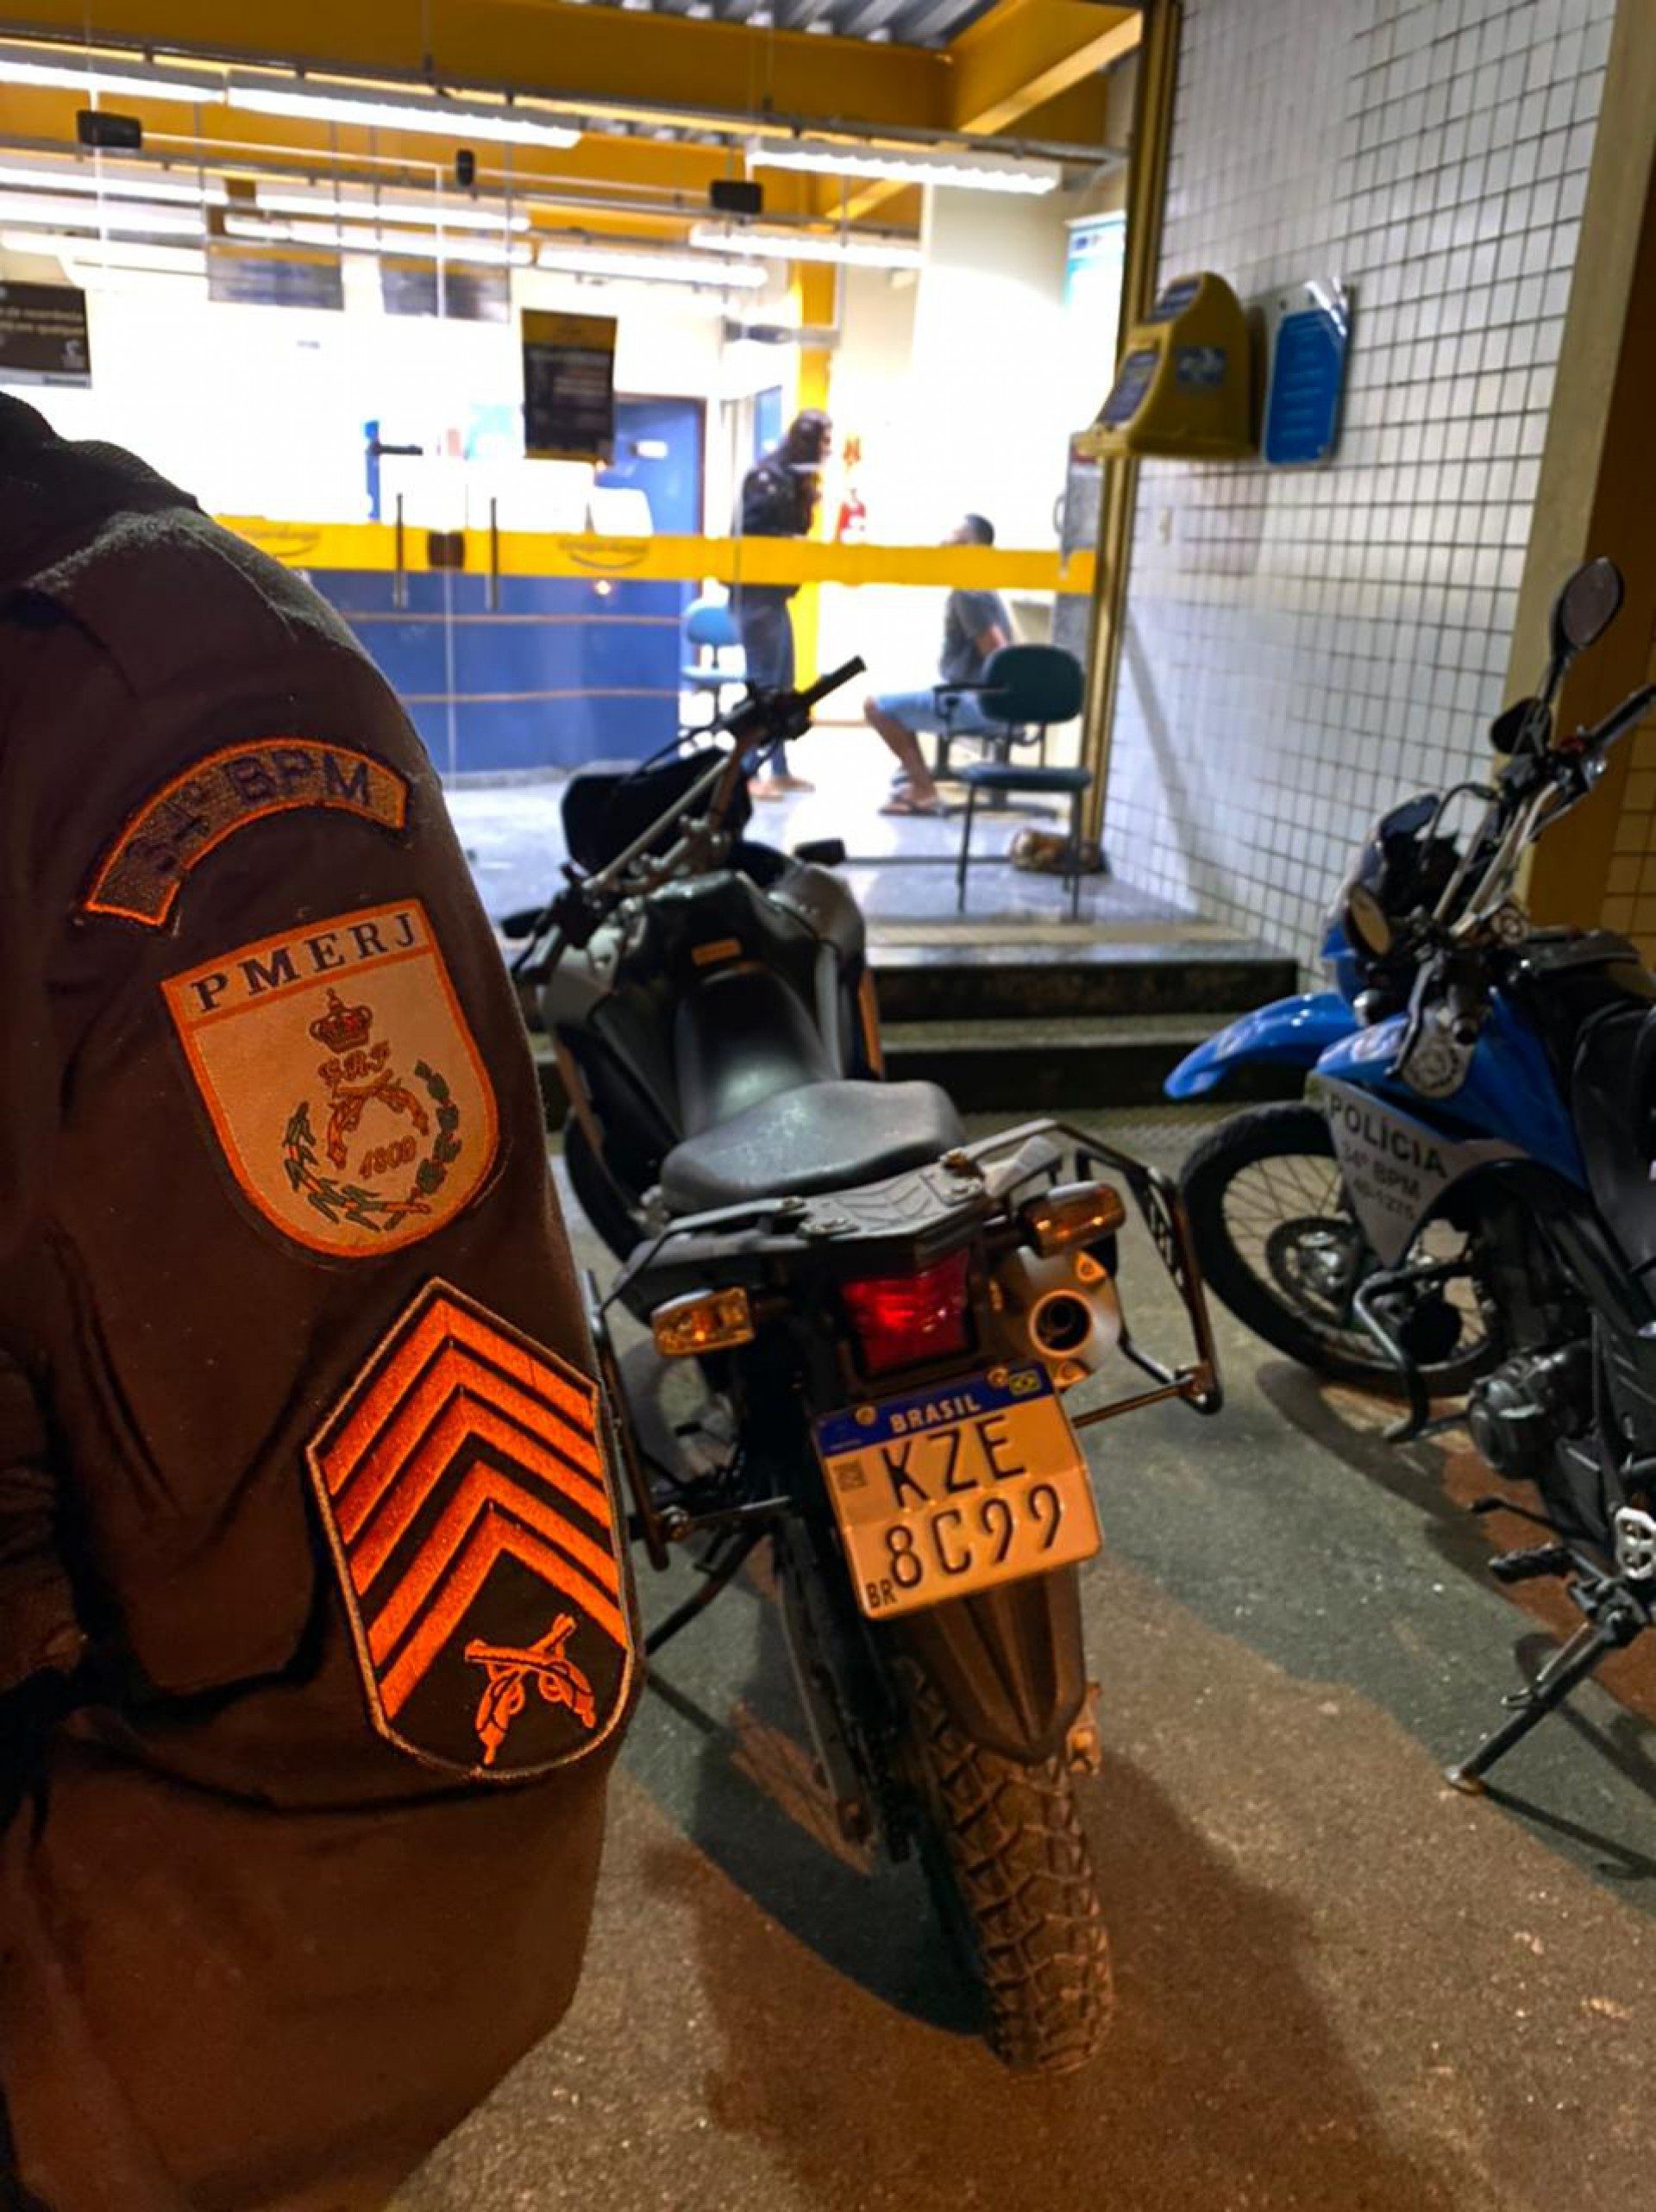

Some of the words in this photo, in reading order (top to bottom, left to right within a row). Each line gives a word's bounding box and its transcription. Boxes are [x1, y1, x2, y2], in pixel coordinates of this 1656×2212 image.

[226, 749, 370, 806] BPM
[191, 912, 420, 1012] PMERJ
[1373, 1160, 1421, 1200] BPM
[888, 1393, 982, 1433] BRASIL
[880, 1414, 1027, 1508] KZE
[885, 1482, 1064, 1589] 8C99
[864, 1577, 898, 1609] BR
